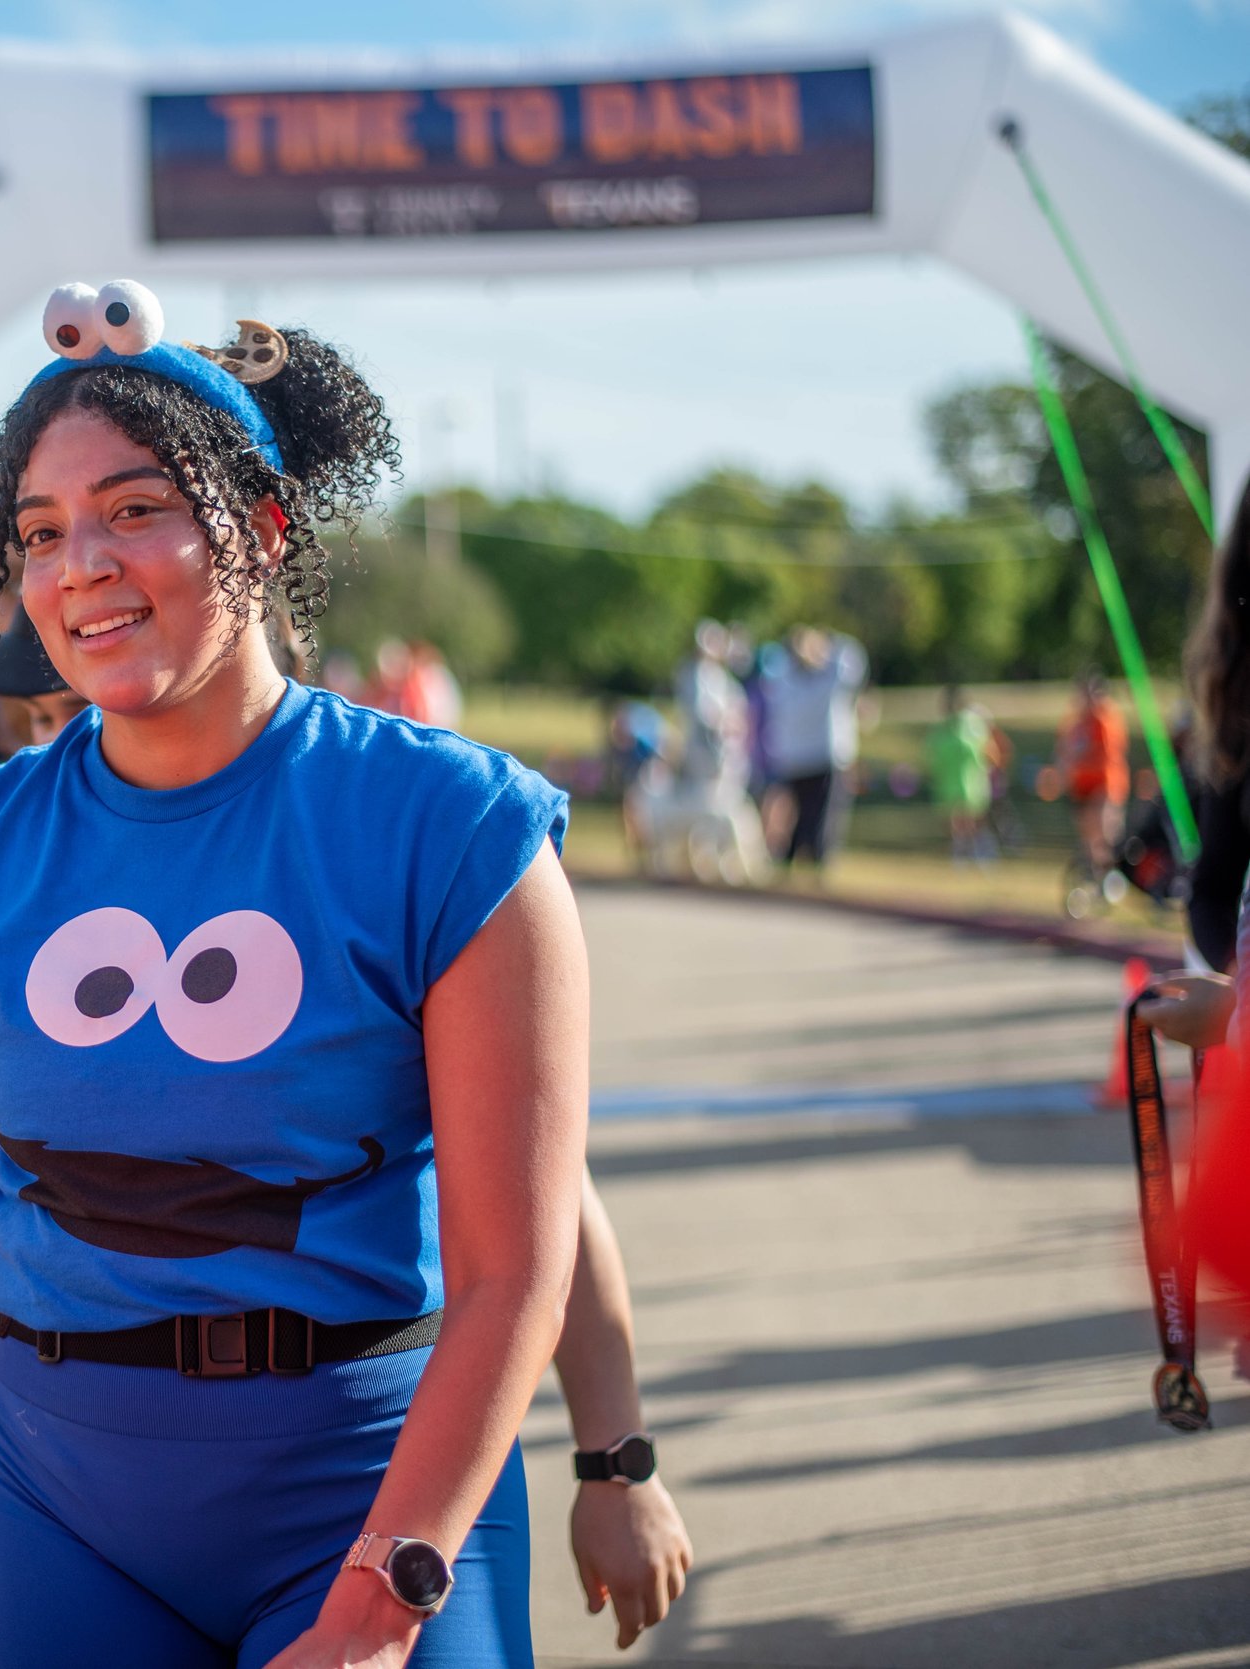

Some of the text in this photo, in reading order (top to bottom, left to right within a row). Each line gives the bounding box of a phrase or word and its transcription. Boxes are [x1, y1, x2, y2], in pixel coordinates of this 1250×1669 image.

[208, 75, 802, 173] TIME TO DASH
[1158, 1267, 1183, 1344] TEXANS
